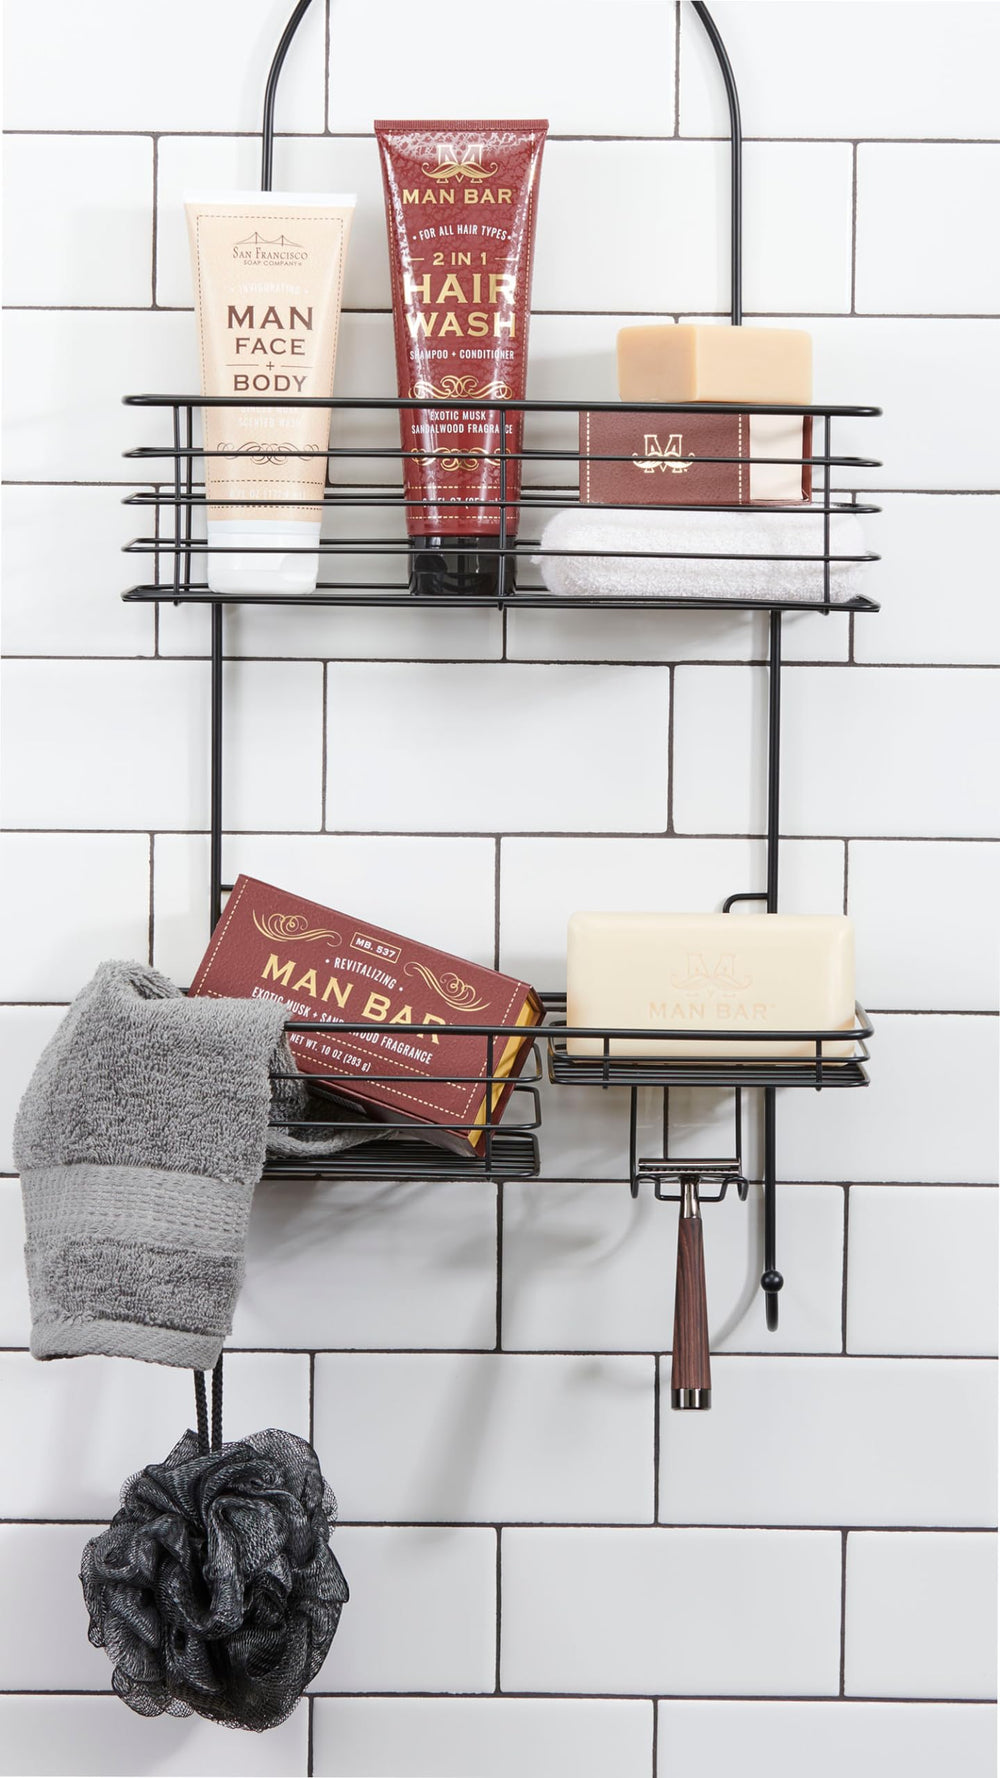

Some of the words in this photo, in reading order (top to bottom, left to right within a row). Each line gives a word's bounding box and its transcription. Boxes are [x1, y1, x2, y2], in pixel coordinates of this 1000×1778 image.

[403, 188, 455, 204] MAN
[464, 188, 512, 204] BAR
[419, 227, 436, 240] FOR
[439, 225, 454, 236] ALL
[457, 224, 478, 235] HAIR
[481, 225, 508, 240] TYPES
[433, 252, 444, 266] 2
[452, 252, 471, 266] IN
[481, 252, 488, 266] 1
[403, 273, 516, 304] HAIR
[227, 305, 313, 330] MAN
[405, 311, 516, 337] WASH
[235, 337, 306, 355] FACE
[409, 349, 449, 360] SHAMPOO
[459, 349, 514, 360] CONDITIONER
[233, 374, 308, 392] BODY
[430, 410, 459, 420] EXOTIC
[463, 410, 487, 420] MUSK
[411, 423, 464, 434] SANDALWOOD
[468, 423, 513, 434] FRAGRACE
[355, 937, 374, 951] MB.
[375, 945, 396, 958] 537
[334, 957, 397, 989] REVITALIZING
[260, 954, 354, 1009] MAN
[361, 991, 447, 1045] BAR
[648, 1001, 705, 1020] MAN
[716, 1002, 768, 1020] BAR
[286, 1000, 311, 1018] MUSK
[380, 1036, 433, 1065] FRAGRANCE
[290, 1033, 304, 1043] NET
[305, 1038, 318, 1051] WT.
[321, 1044, 330, 1055] 10
[332, 1048, 343, 1060] OZ
[343, 1053, 362, 1068] (283
